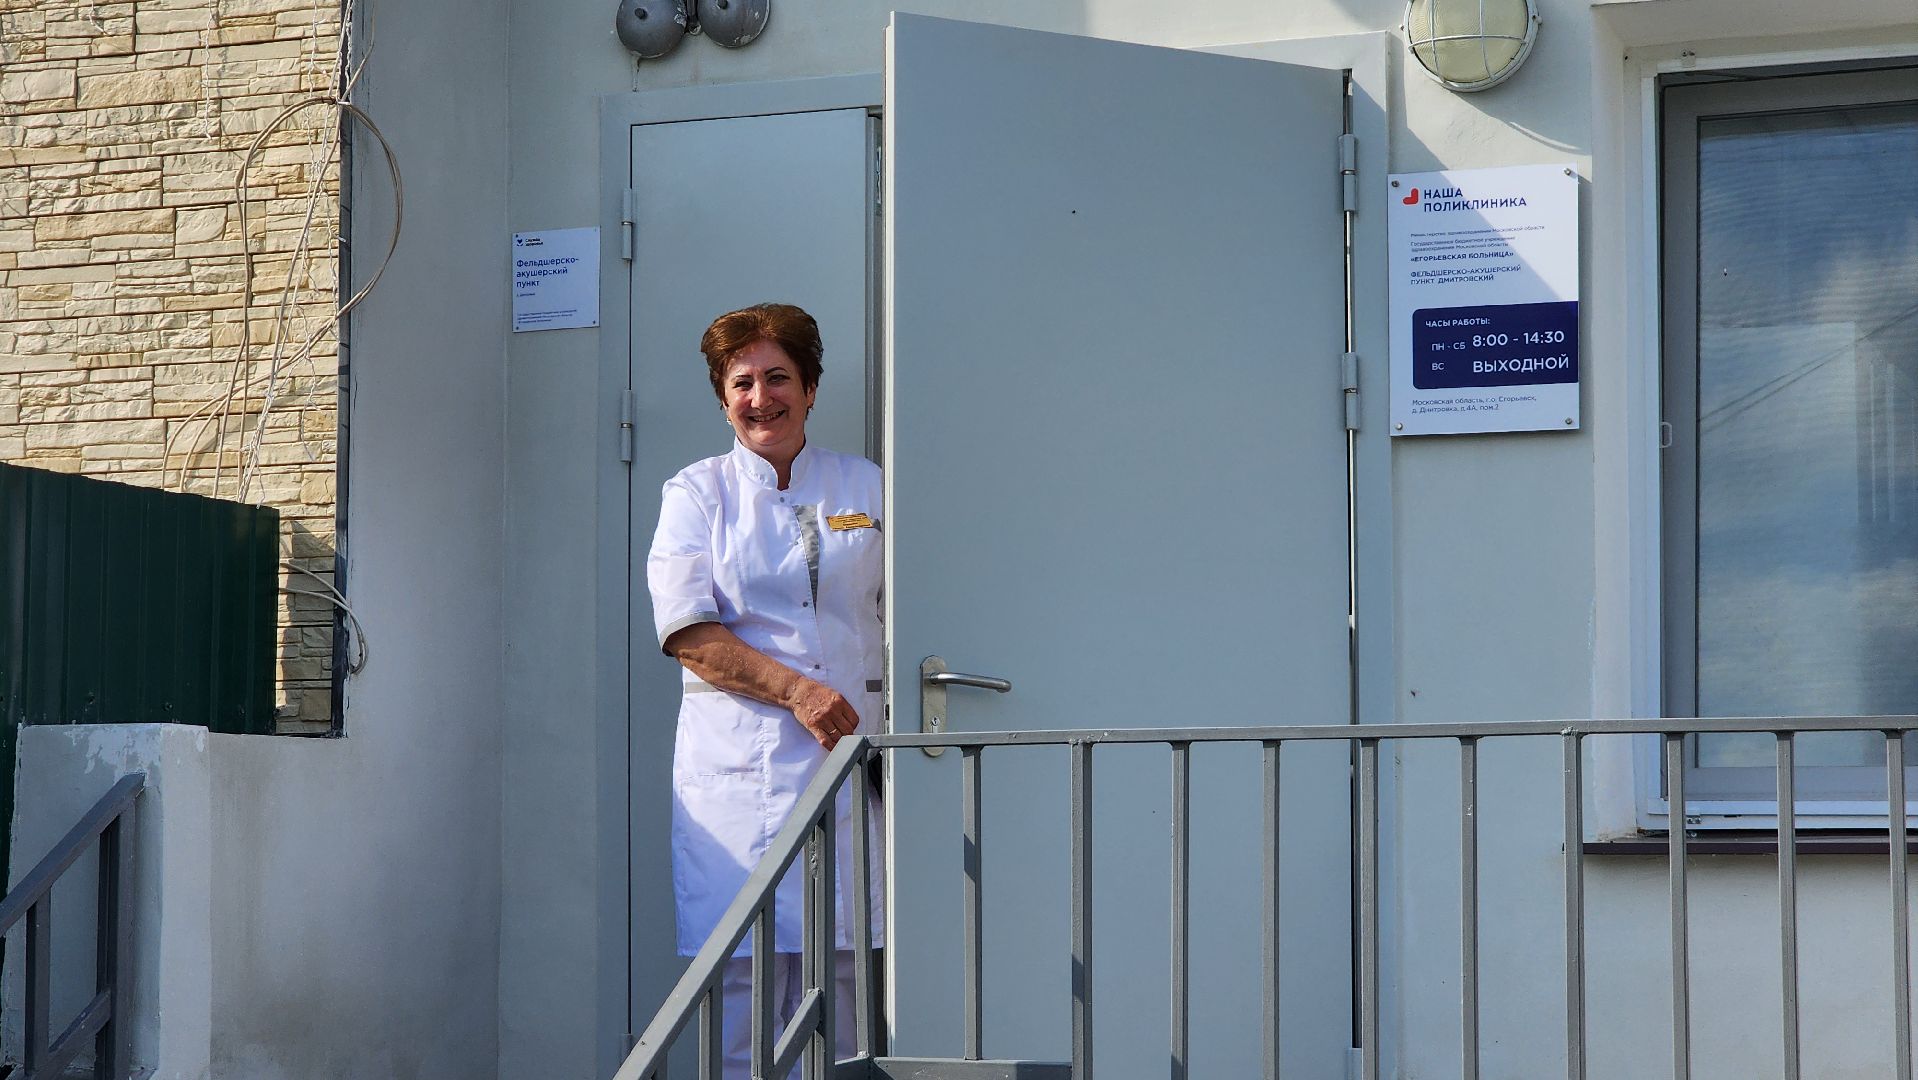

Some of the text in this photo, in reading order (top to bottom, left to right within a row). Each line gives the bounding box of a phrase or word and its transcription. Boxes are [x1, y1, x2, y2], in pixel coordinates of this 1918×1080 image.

[1424, 188, 1463, 199] НАША
[1424, 197, 1527, 212] ПОЛИКЛИНИКА
[517, 257, 580, 267] Фельдшерско-
[1411, 251, 1514, 262] «ЕГОРЬЕВСКАЯ БОЛЬНИЦА»
[517, 267, 568, 278] акушерский
[1411, 264, 1522, 277] ФЕЛЬДШЕРСКО-АКУШЕРСКИЙ
[517, 280, 540, 289] пункт
[1438, 274, 1494, 284] ДМИТРОВСКИЙ
[1425, 317, 1491, 328] ЧАСЫ РАБОТЫ:
[1431, 343, 1445, 351] ПН
[1453, 342, 1466, 350] СБ
[1472, 333, 1508, 348] 8:00
[1523, 330, 1565, 345] 14:30
[1431, 353, 1569, 373] ВС ВЫХОДНОЙ
